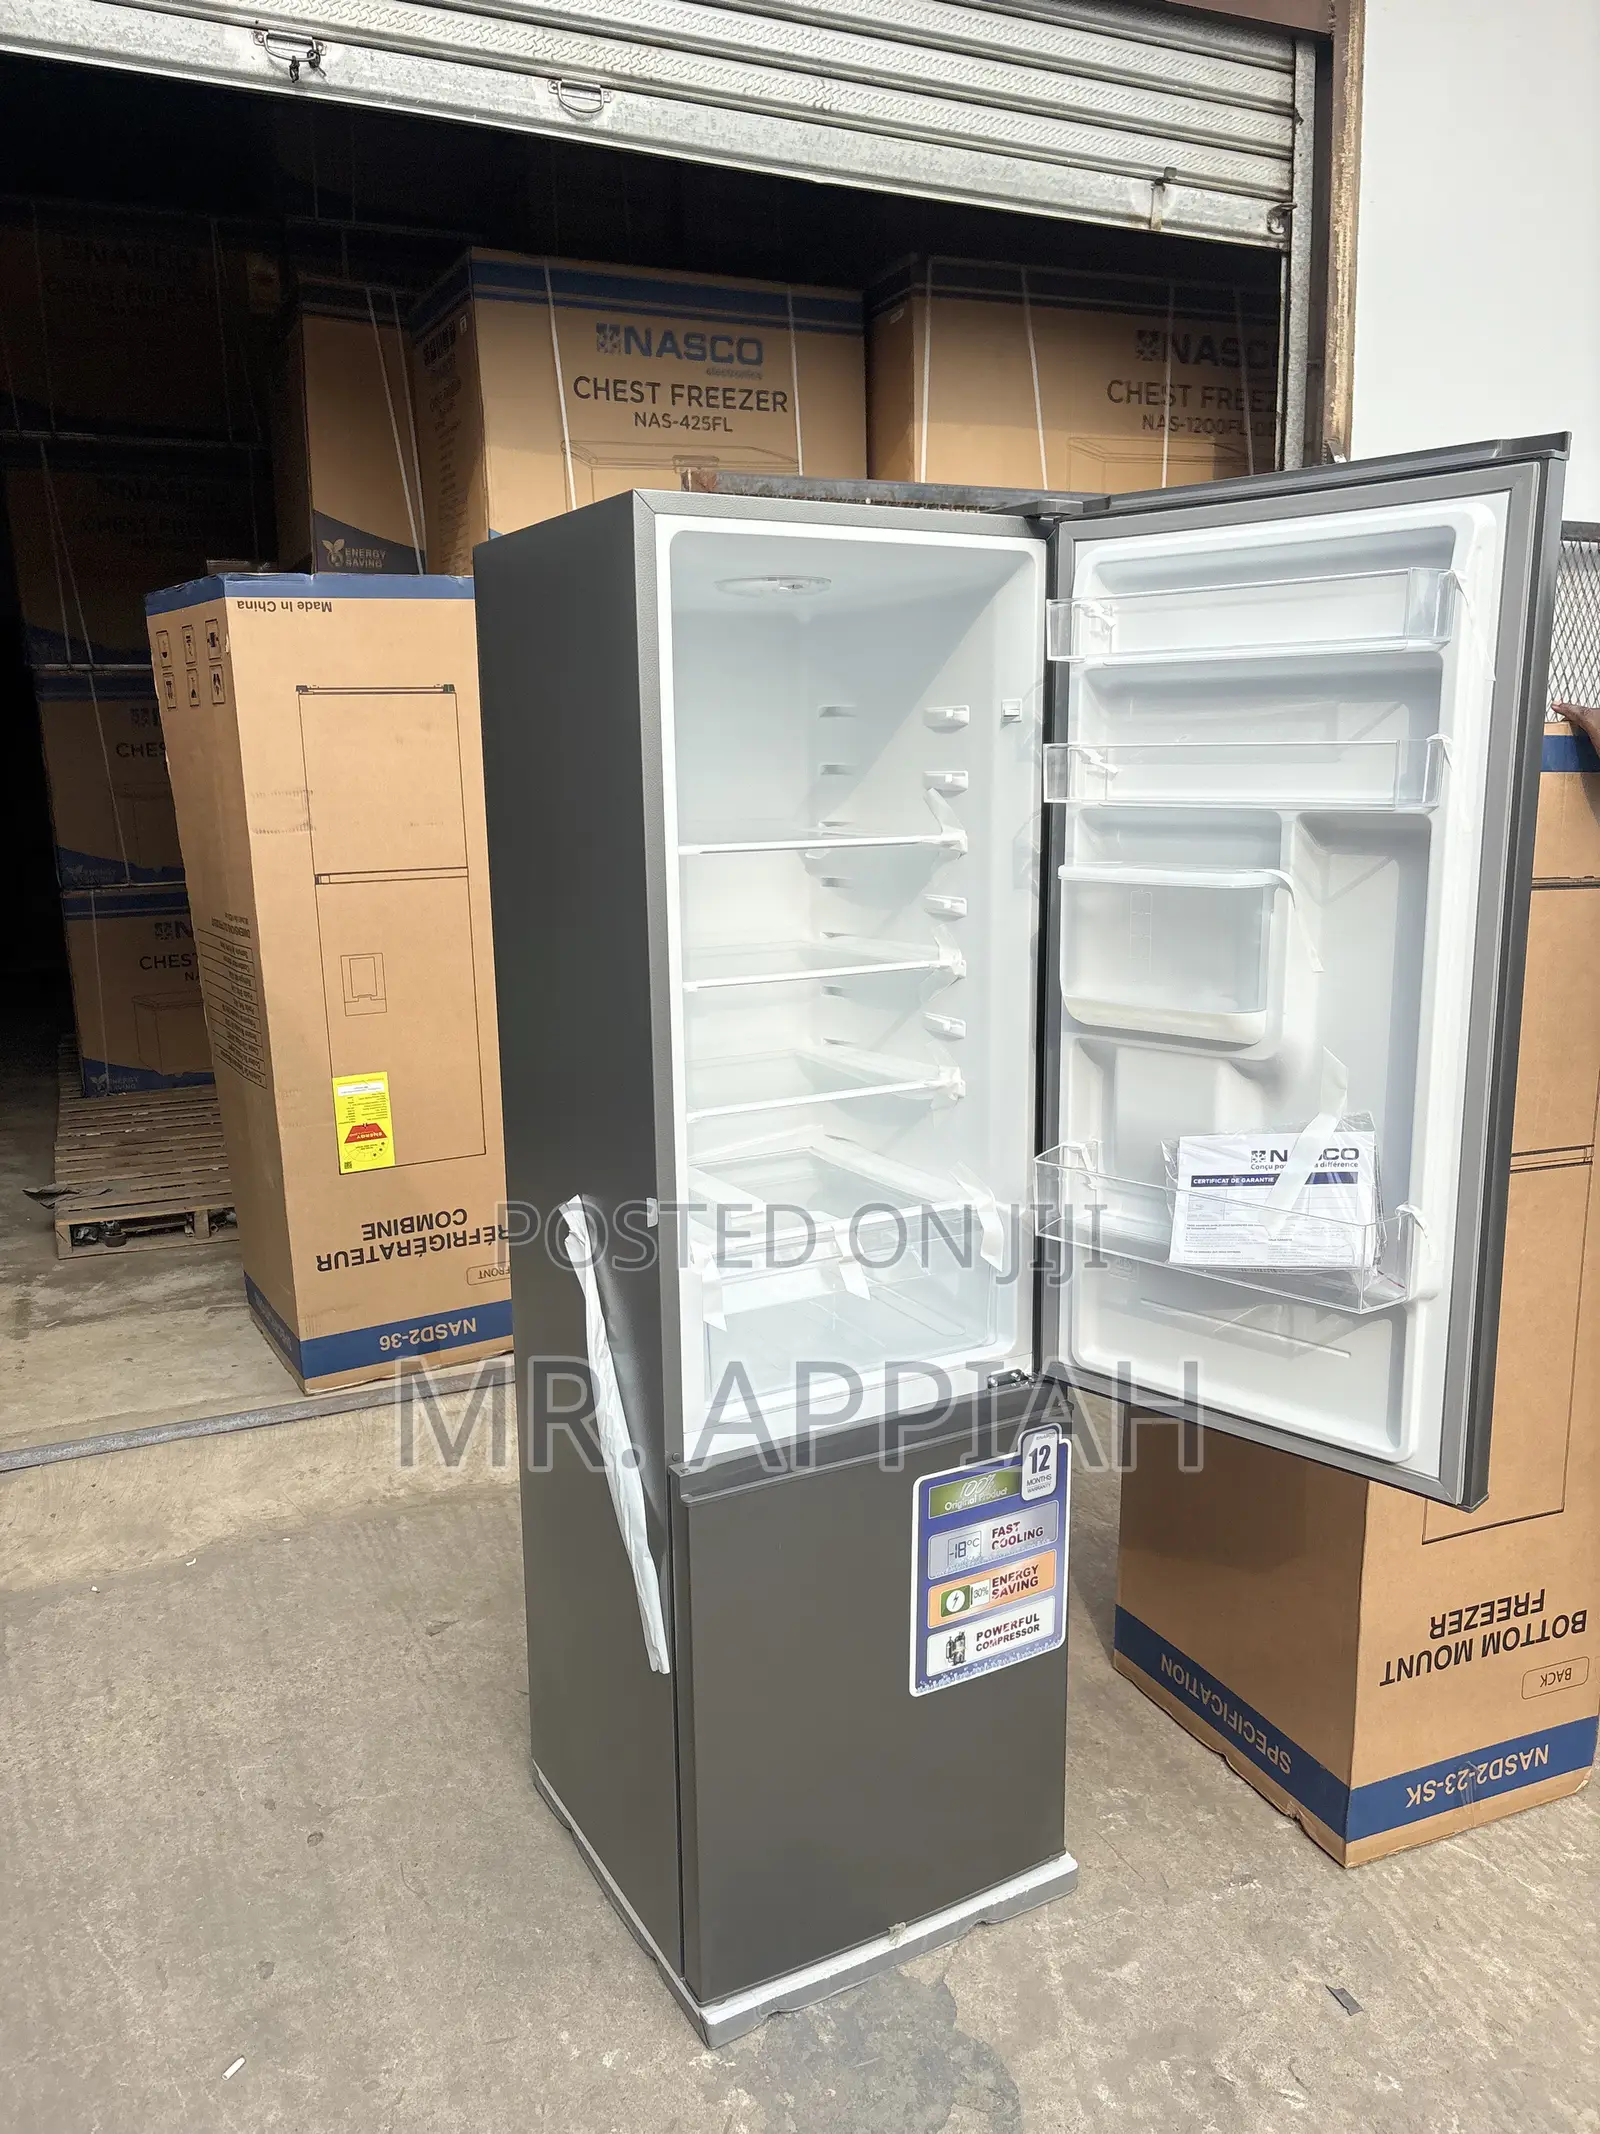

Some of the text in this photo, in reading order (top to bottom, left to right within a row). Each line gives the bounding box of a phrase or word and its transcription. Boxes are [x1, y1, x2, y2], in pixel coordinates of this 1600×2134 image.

[624, 325, 763, 366] NASCO
[1162, 332, 1278, 370] NASC
[573, 375, 788, 413] CHEST FREEZER
[1106, 379, 1192, 408] CHEST
[634, 411, 733, 433] NAS-425FL
[237, 600, 333, 612] Made In China
[115, 741, 167, 759] CHES
[1250, 1163, 1273, 1171] Conçu
[1270, 1147, 1360, 1163] NCO
[1193, 1176, 1276, 1186] CERTIFICAT DE GARANTIE
[361, 1208, 468, 1242] COMBINE
[316, 1224, 509, 1272] RÉFRIGÉRATEUR
[379, 1317, 477, 1351] NASD2-36
[1029, 1444, 1051, 1475] 12
[1026, 1474, 1052, 1487] MONTHS
[944, 1486, 1008, 1512] Original Product
[991, 1526, 1044, 1551] COOLING
[992, 1521, 1021, 1539] FAST
[991, 1575, 1039, 1599] SAVING
[992, 1564, 1039, 1588] ENERGY
[973, 1585, 989, 1599] 30%
[976, 1613, 1040, 1642] POWERFUL
[1429, 1588, 1546, 1640] FREEZER
[976, 1623, 1040, 1652] COMPRESSOR
[1379, 1609, 1588, 1687] BOTTOM MOUNT
[1539, 1666, 1572, 1688] BACK
[1160, 1653, 1292, 1775] SPECIFICATION
[1405, 1743, 1549, 1808] NASD2-23-SK
